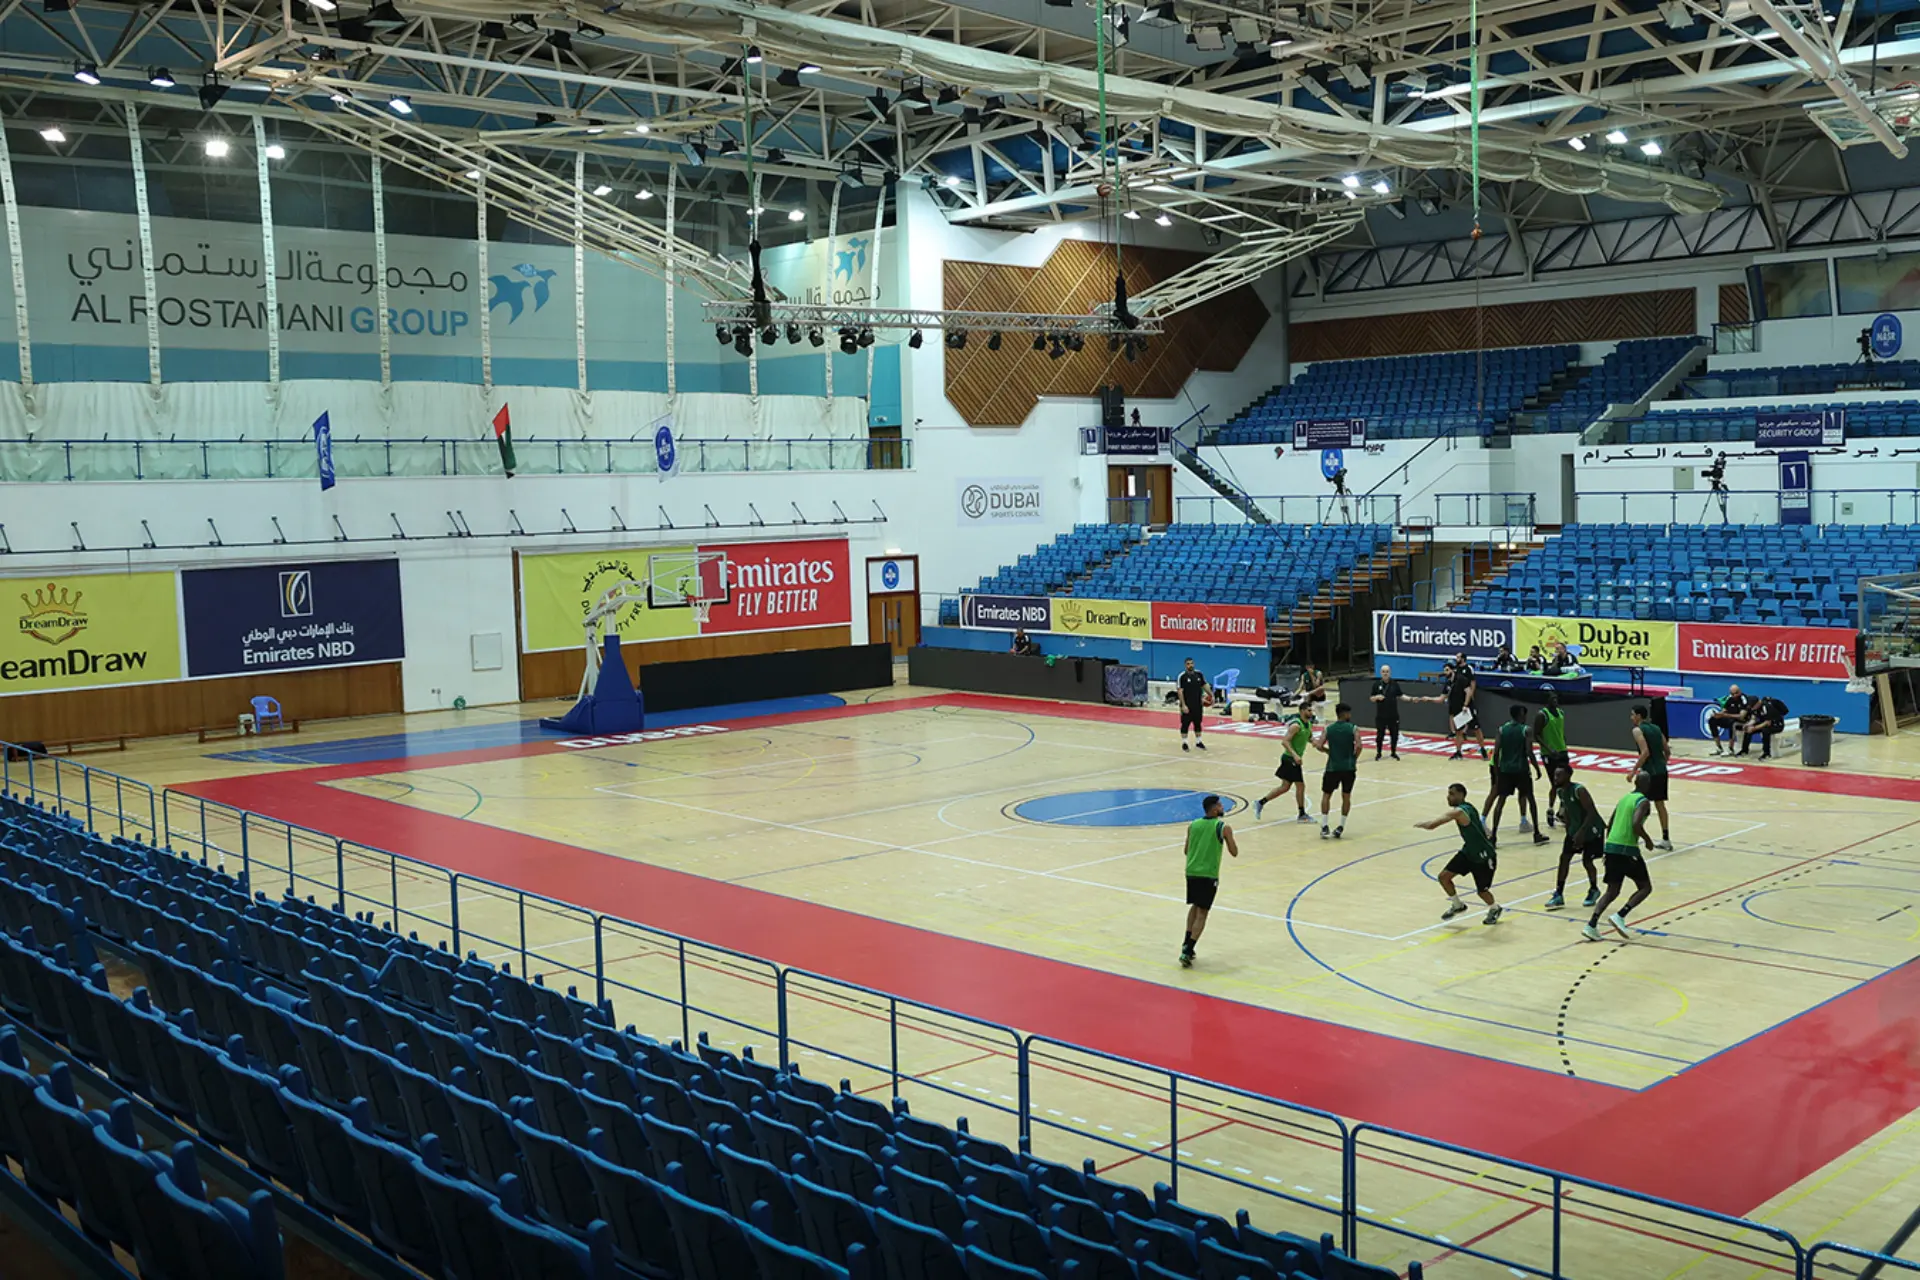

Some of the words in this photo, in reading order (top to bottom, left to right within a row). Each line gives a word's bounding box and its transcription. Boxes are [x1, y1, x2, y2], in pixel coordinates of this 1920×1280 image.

[350, 306, 469, 336] GROUP
[1758, 427, 1793, 438] SECURITY
[1794, 426, 1821, 437] GROUP
[1582, 447, 1667, 465] الكرام
[990, 492, 1040, 509] DUBAI
[717, 556, 834, 590] Emirates
[737, 592, 762, 617] FLY
[767, 588, 819, 614] BETTER
[20, 616, 88, 629] DreamDraw
[977, 604, 1021, 622] Emirates
[1022, 607, 1047, 622] NBD
[1086, 609, 1147, 628] DreamDraw
[299, 622, 335, 639] الإمارات
[336, 621, 354, 636] بنك
[1160, 613, 1209, 631] Emirates
[1211, 616, 1226, 632] FLY
[1226, 617, 1257, 634] BETTER
[242, 627, 275, 647] الوطني
[276, 629, 298, 645] دبي
[1401, 625, 1466, 646] Emirates
[1470, 628, 1506, 648] NBD
[1578, 622, 1650, 646] Dubai
[243, 646, 316, 664] Emirates
[318, 640, 356, 658] NBD
[1617, 646, 1651, 661] Free
[1692, 638, 1770, 661] Emirates
[1774, 642, 1797, 662] FLY
[1799, 642, 1846, 664] BETTER
